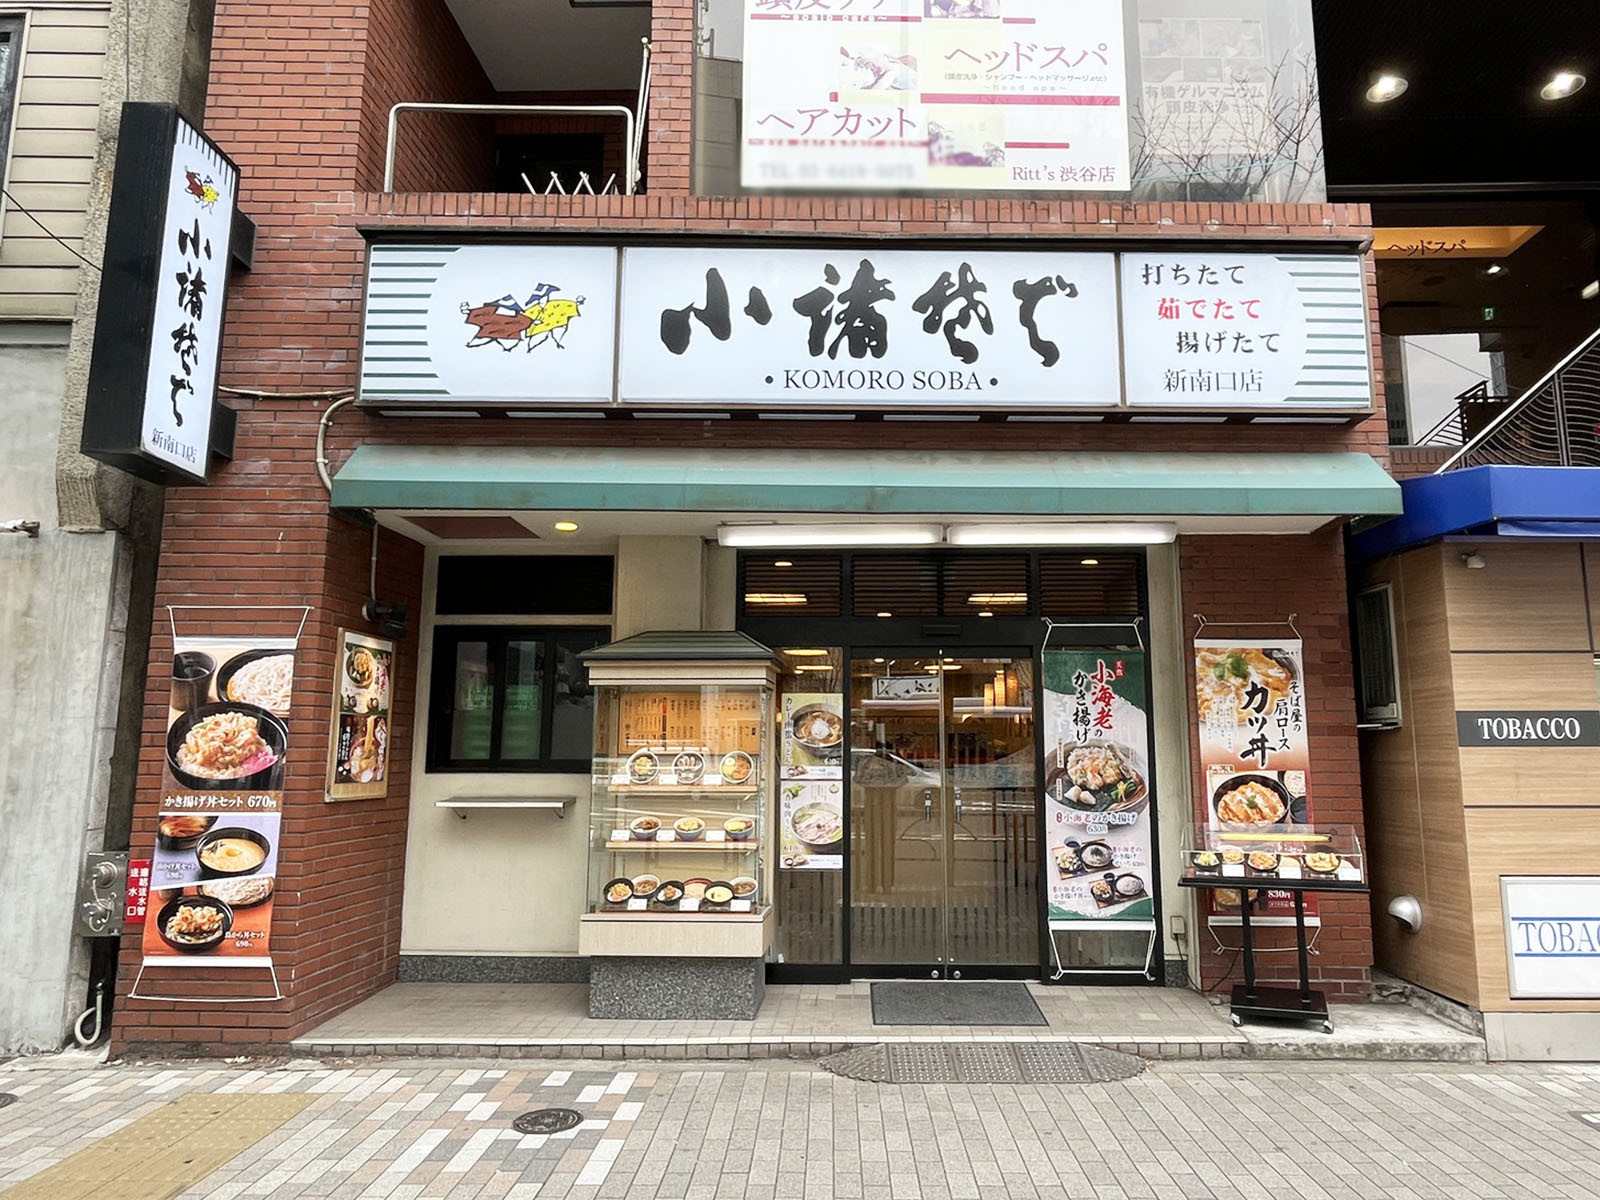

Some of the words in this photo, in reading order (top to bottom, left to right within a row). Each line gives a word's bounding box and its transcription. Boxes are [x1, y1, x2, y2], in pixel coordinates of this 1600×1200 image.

[944, 41, 1108, 72] ヘッドスパ
[756, 106, 917, 138] ヘアカット
[1060, 166, 1116, 182] 渋谷店
[1387, 239, 1467, 256] ヘッドスパ
[1142, 263, 1245, 285] 打ちたて
[1157, 297, 1261, 320] 茹でたて
[1176, 330, 1280, 353] 揚げたて
[784, 369, 904, 390] KOMORO
[912, 371, 983, 391] SOBA
[1164, 369, 1263, 392] 新南口店
[151, 426, 198, 464] 新南口店
[1072, 670, 1091, 744] かき揚げ
[1090, 659, 1116, 738] 小海老の
[1290, 681, 1302, 732] そば屋の
[1240, 680, 1278, 767] カツ丼
[1275, 698, 1291, 751] 肩ロース
[1478, 717, 1580, 739] TOBACCO
[164, 795, 244, 808] かき揚げ丼セット
[247, 795, 277, 808] 670円
[1518, 922, 1600, 953] TOBA
